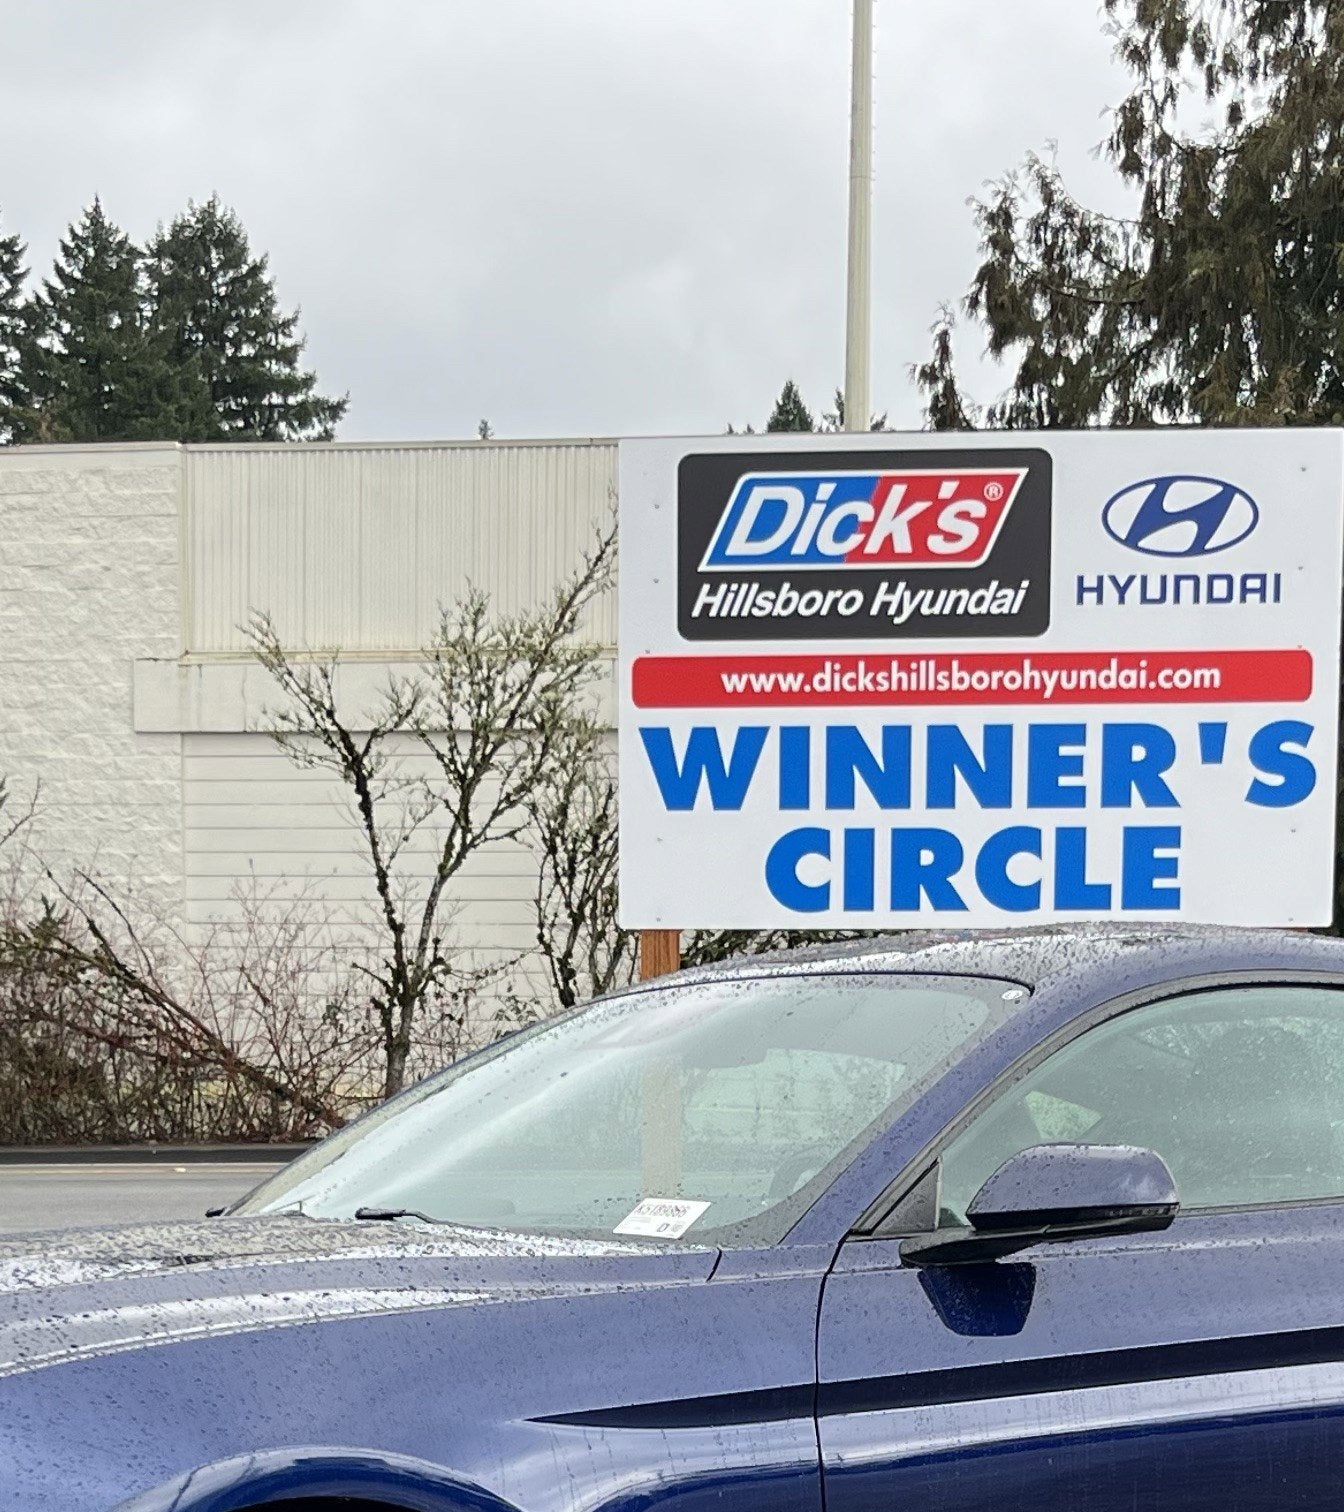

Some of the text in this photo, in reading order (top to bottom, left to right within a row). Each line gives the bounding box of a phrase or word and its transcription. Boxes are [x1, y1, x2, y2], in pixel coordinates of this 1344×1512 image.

[724, 479, 988, 556] Dick's
[691, 580, 1030, 624] Hillsboro Hyundai
[1076, 573, 1282, 605] HYUNDAI
[720, 657, 1222, 700] www.dickshillsborohyundai.com
[640, 719, 1317, 811] WINNER'S
[764, 824, 1182, 912] CIRCLE
